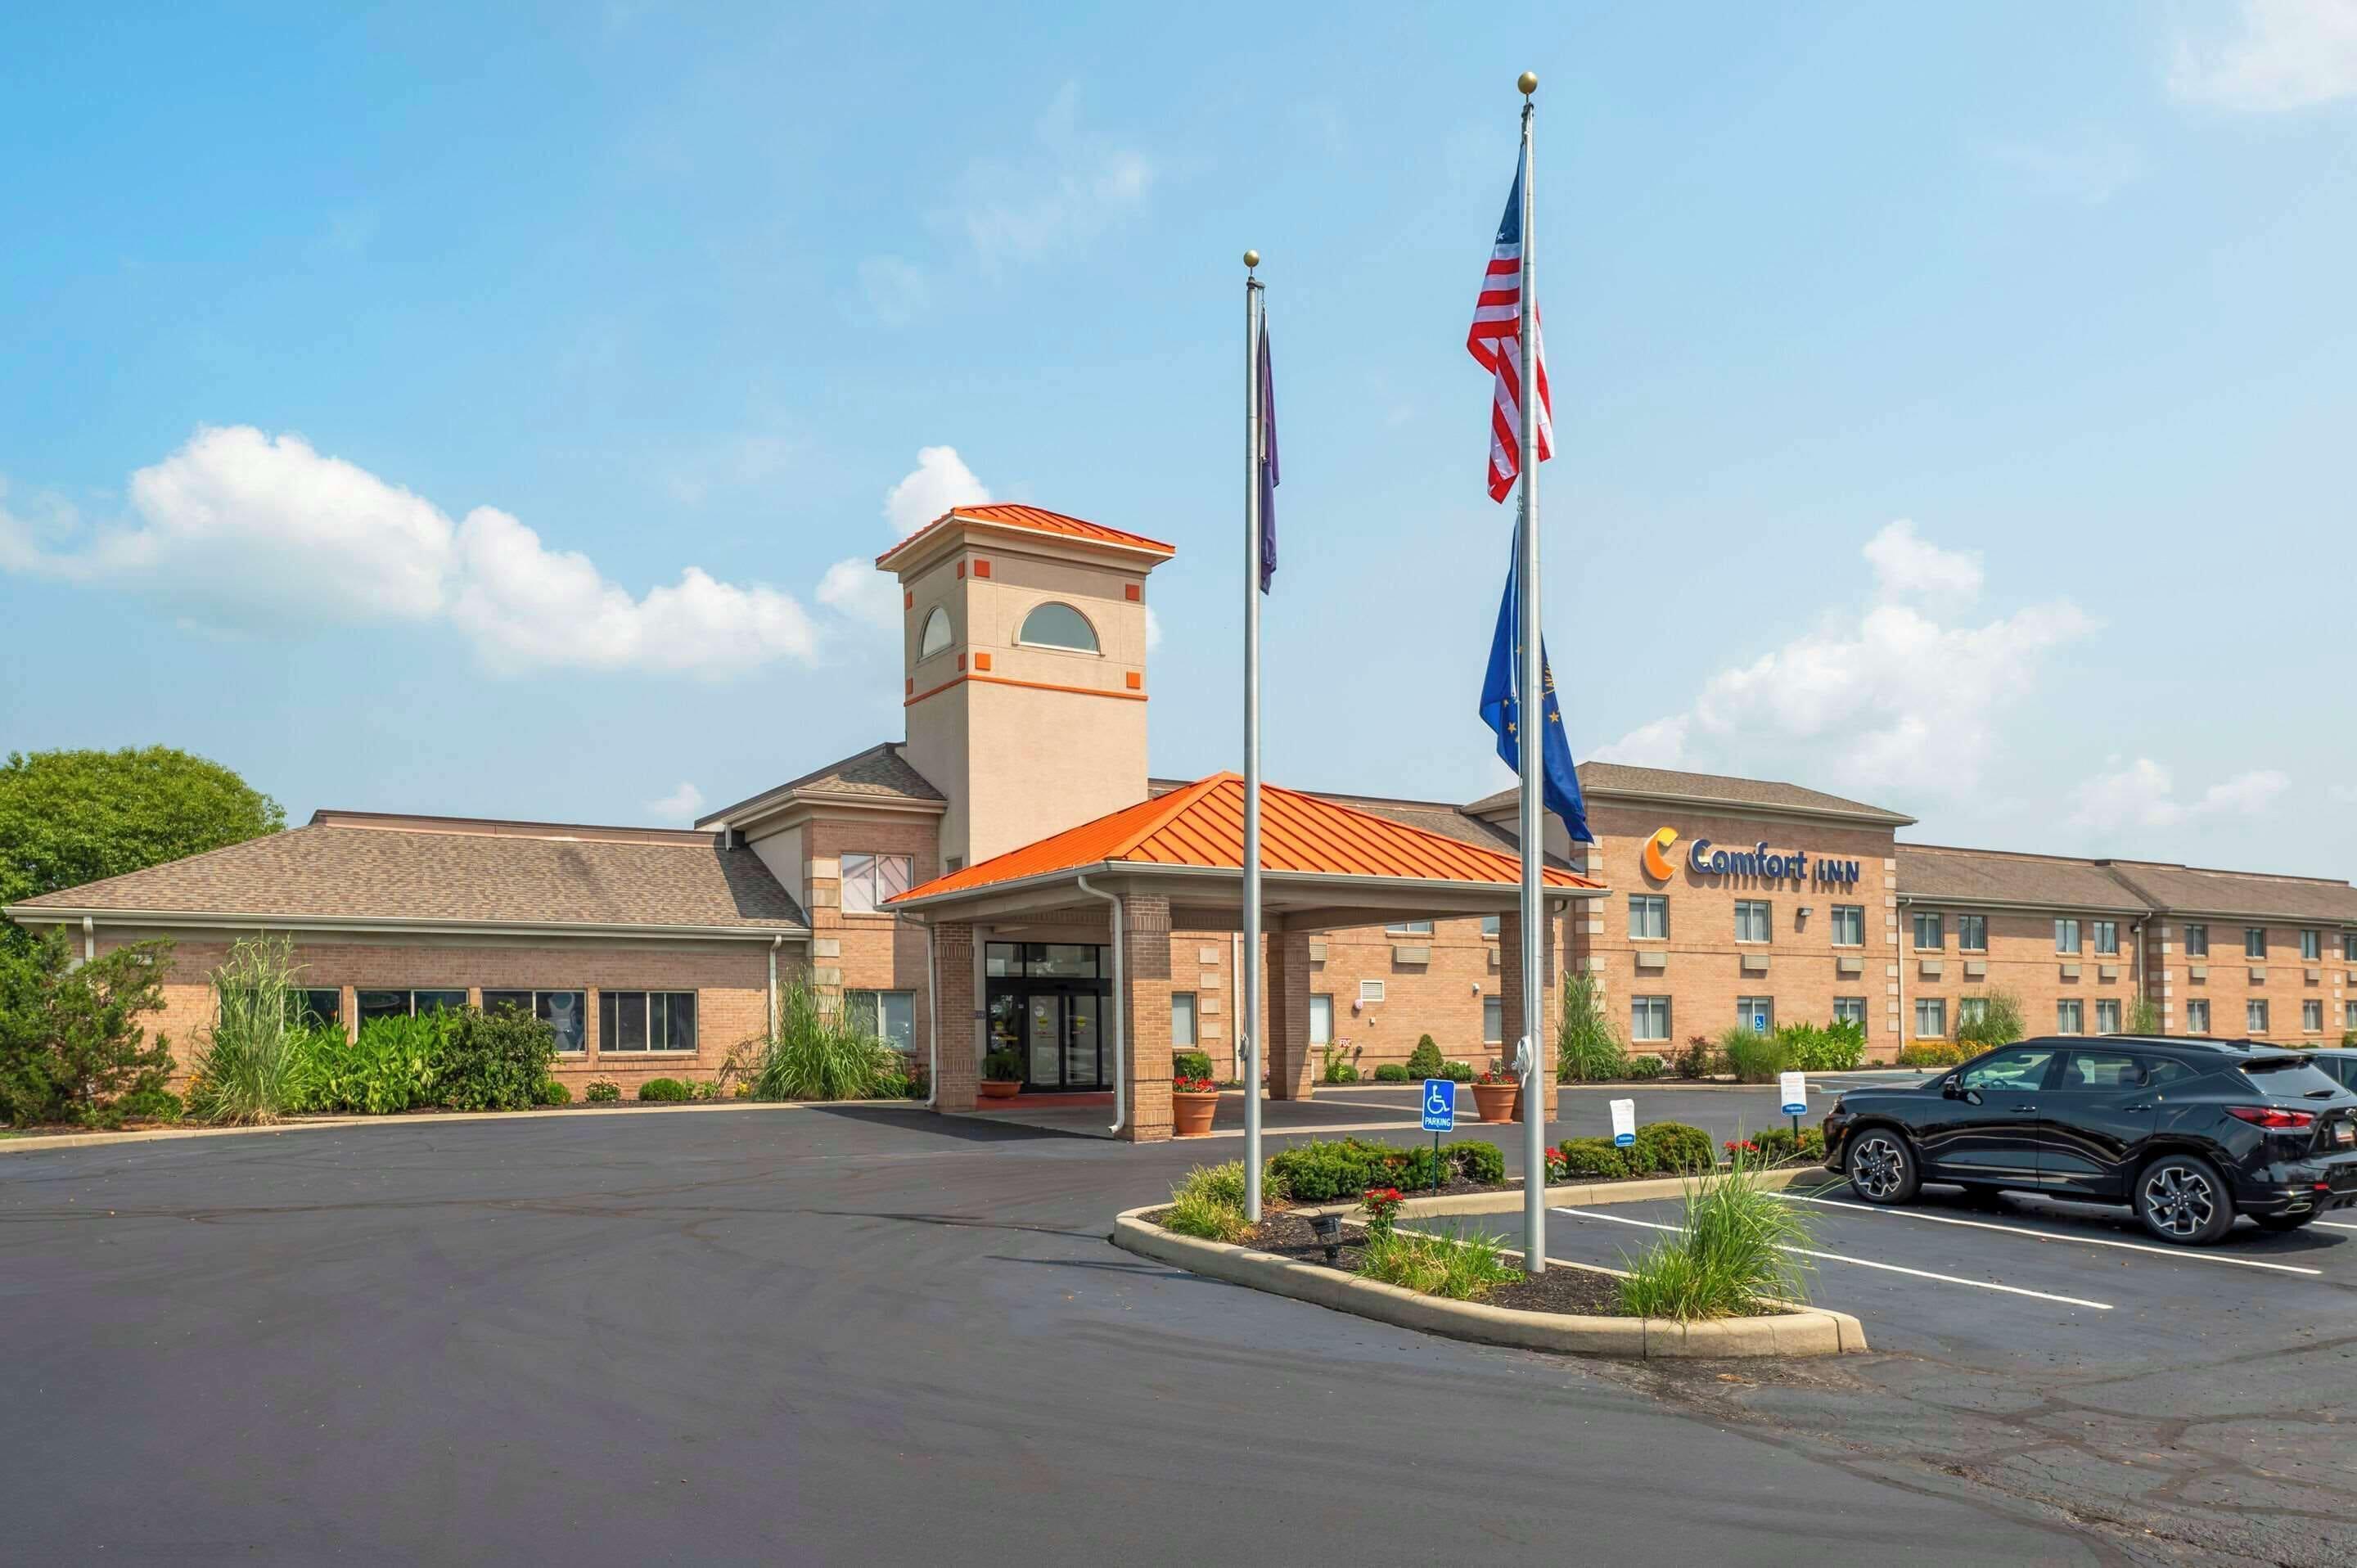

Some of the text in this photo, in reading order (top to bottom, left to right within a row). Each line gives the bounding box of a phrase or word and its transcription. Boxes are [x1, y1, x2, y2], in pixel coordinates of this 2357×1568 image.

[1688, 838, 1807, 880] Comfort
[1814, 858, 1859, 883] INN
[1425, 1117, 1451, 1127] PARKING
